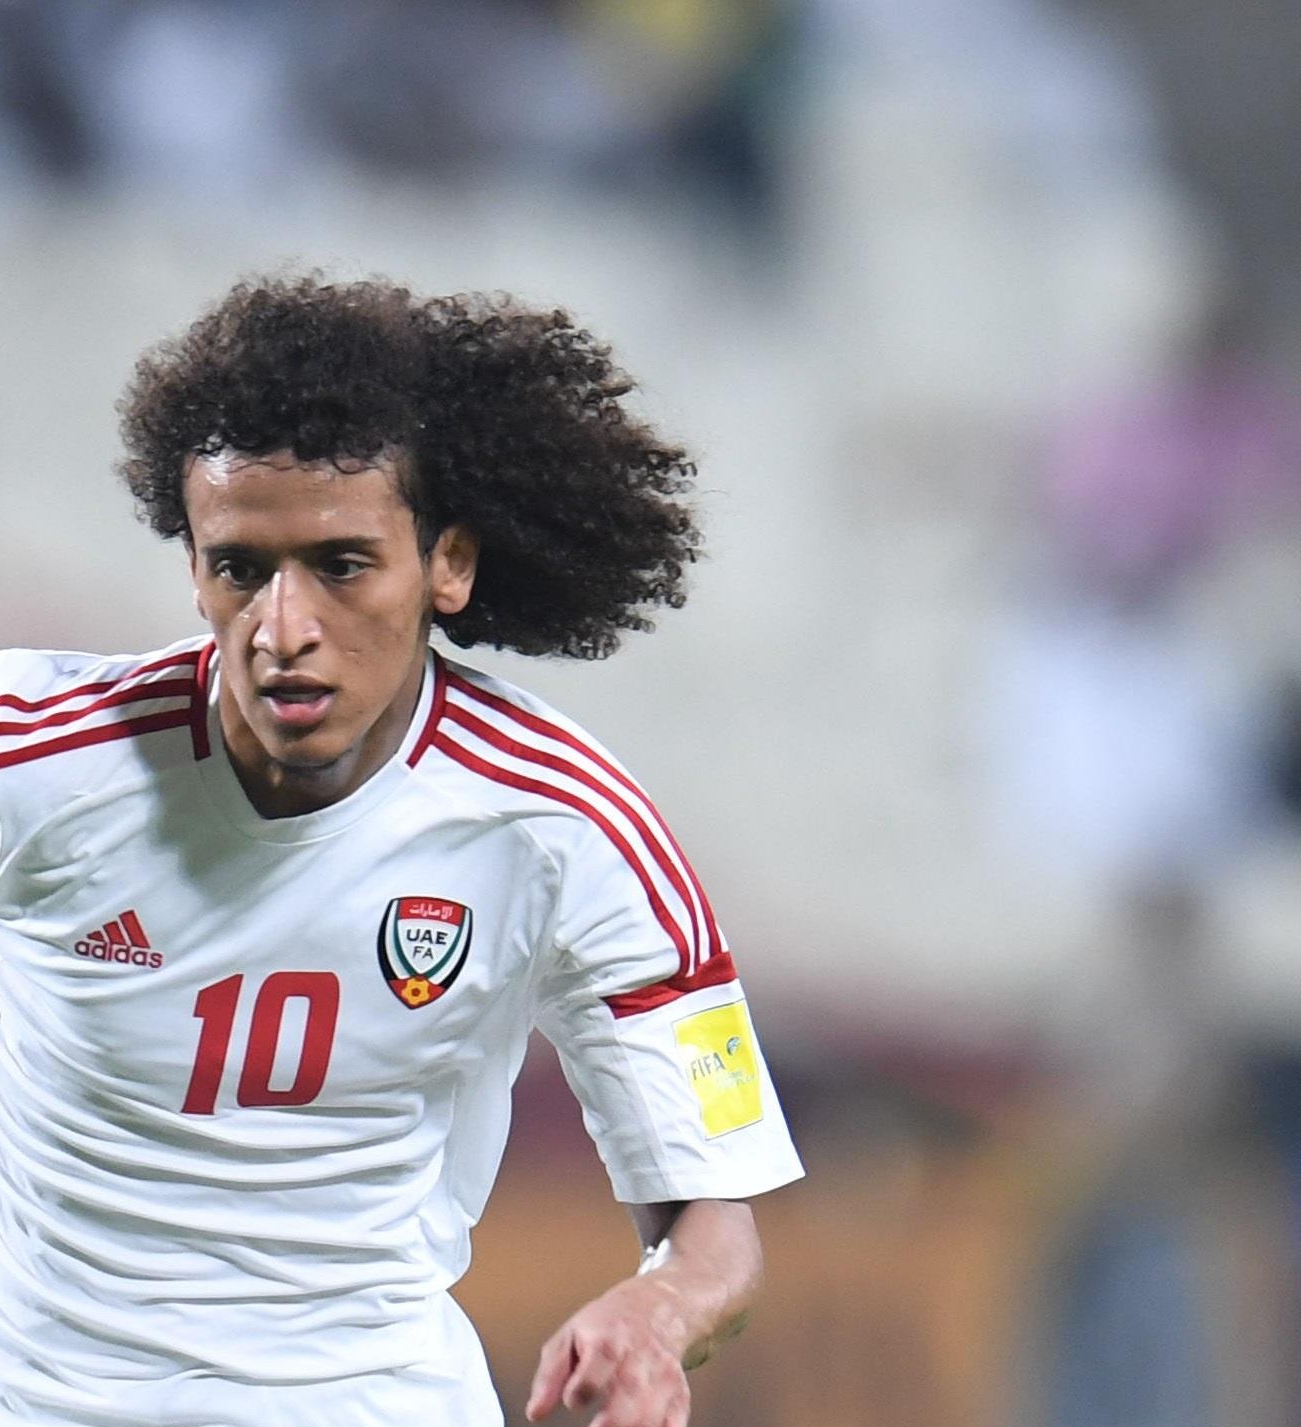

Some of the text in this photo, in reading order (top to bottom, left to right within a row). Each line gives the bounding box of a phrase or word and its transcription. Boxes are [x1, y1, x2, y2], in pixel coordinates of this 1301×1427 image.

[406, 928, 449, 946] UAE
[74, 940, 164, 969] adidas
[412, 945, 434, 960] FA
[181, 972, 340, 1115] 10
[690, 1052, 726, 1081] FIFA
